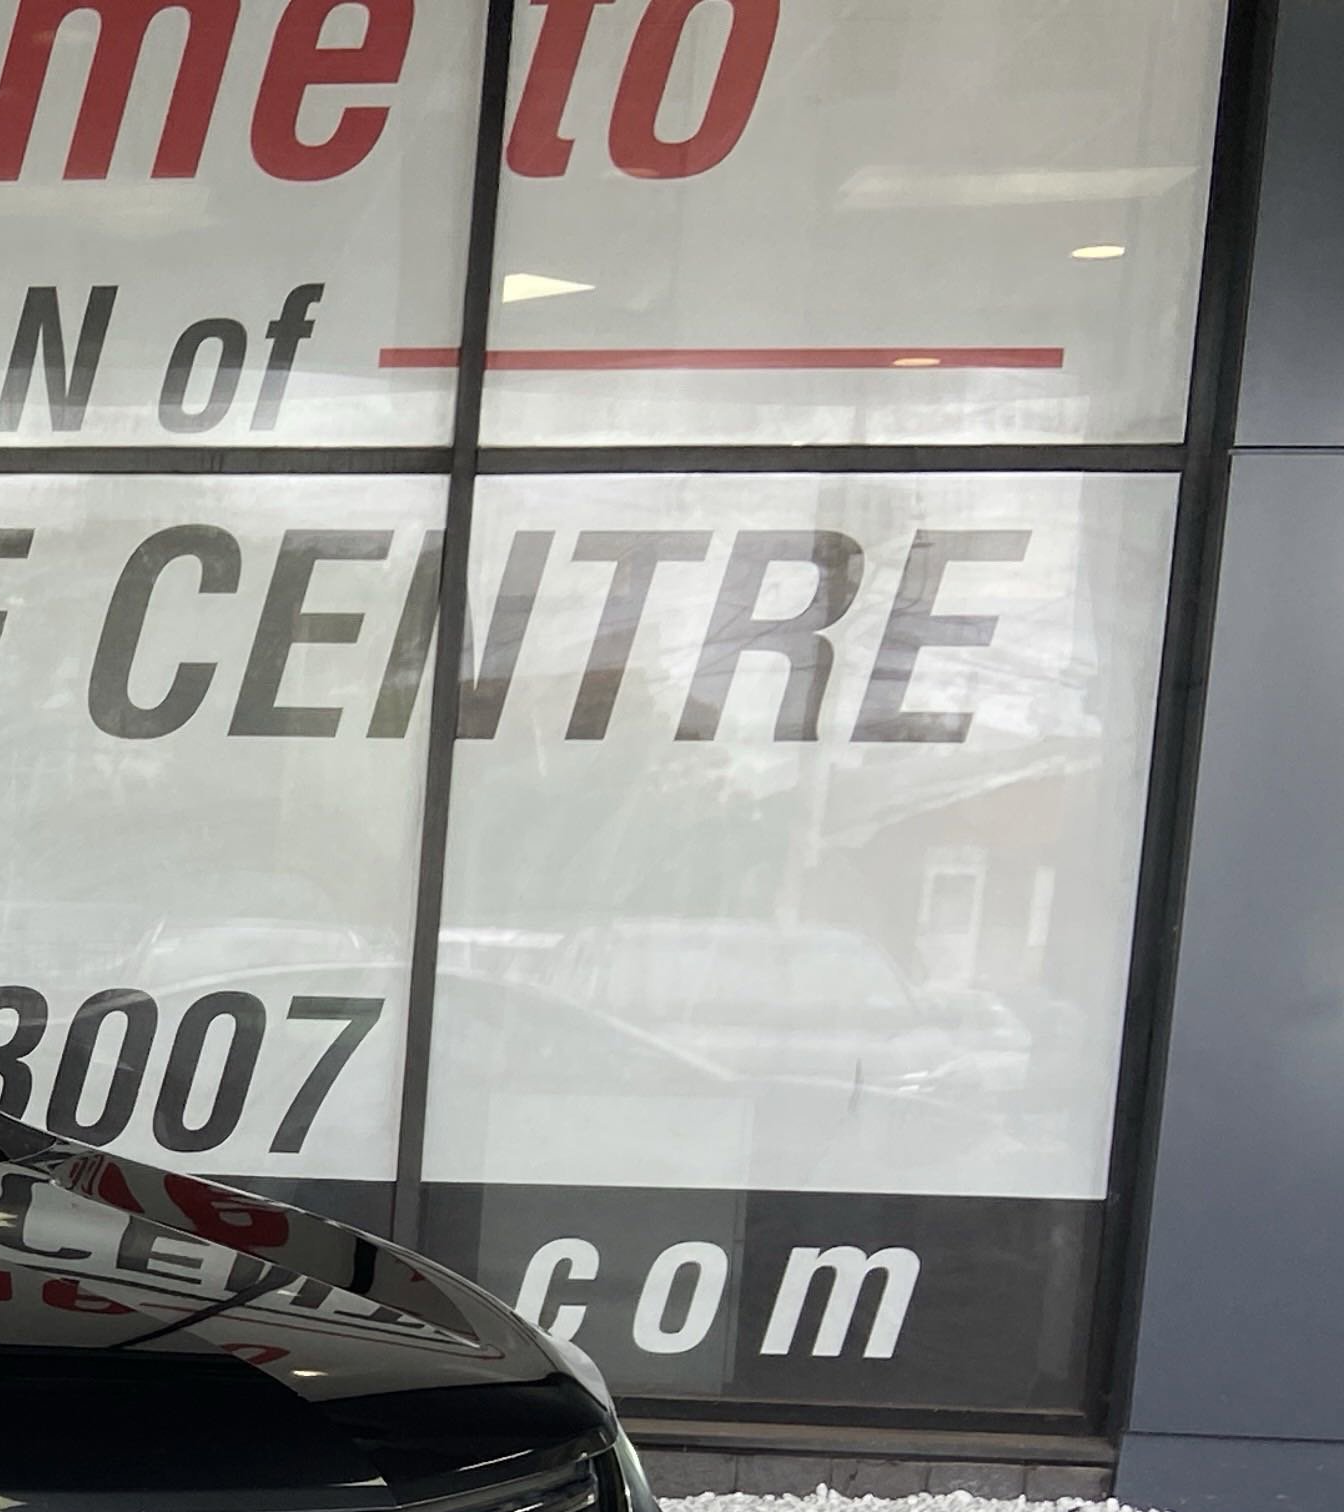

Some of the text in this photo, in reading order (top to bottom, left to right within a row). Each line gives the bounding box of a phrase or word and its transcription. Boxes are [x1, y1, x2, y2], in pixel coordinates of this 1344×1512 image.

[504, 0, 780, 180] to
[154, 282, 325, 434] of
[87, 524, 1032, 744] CENTRE
